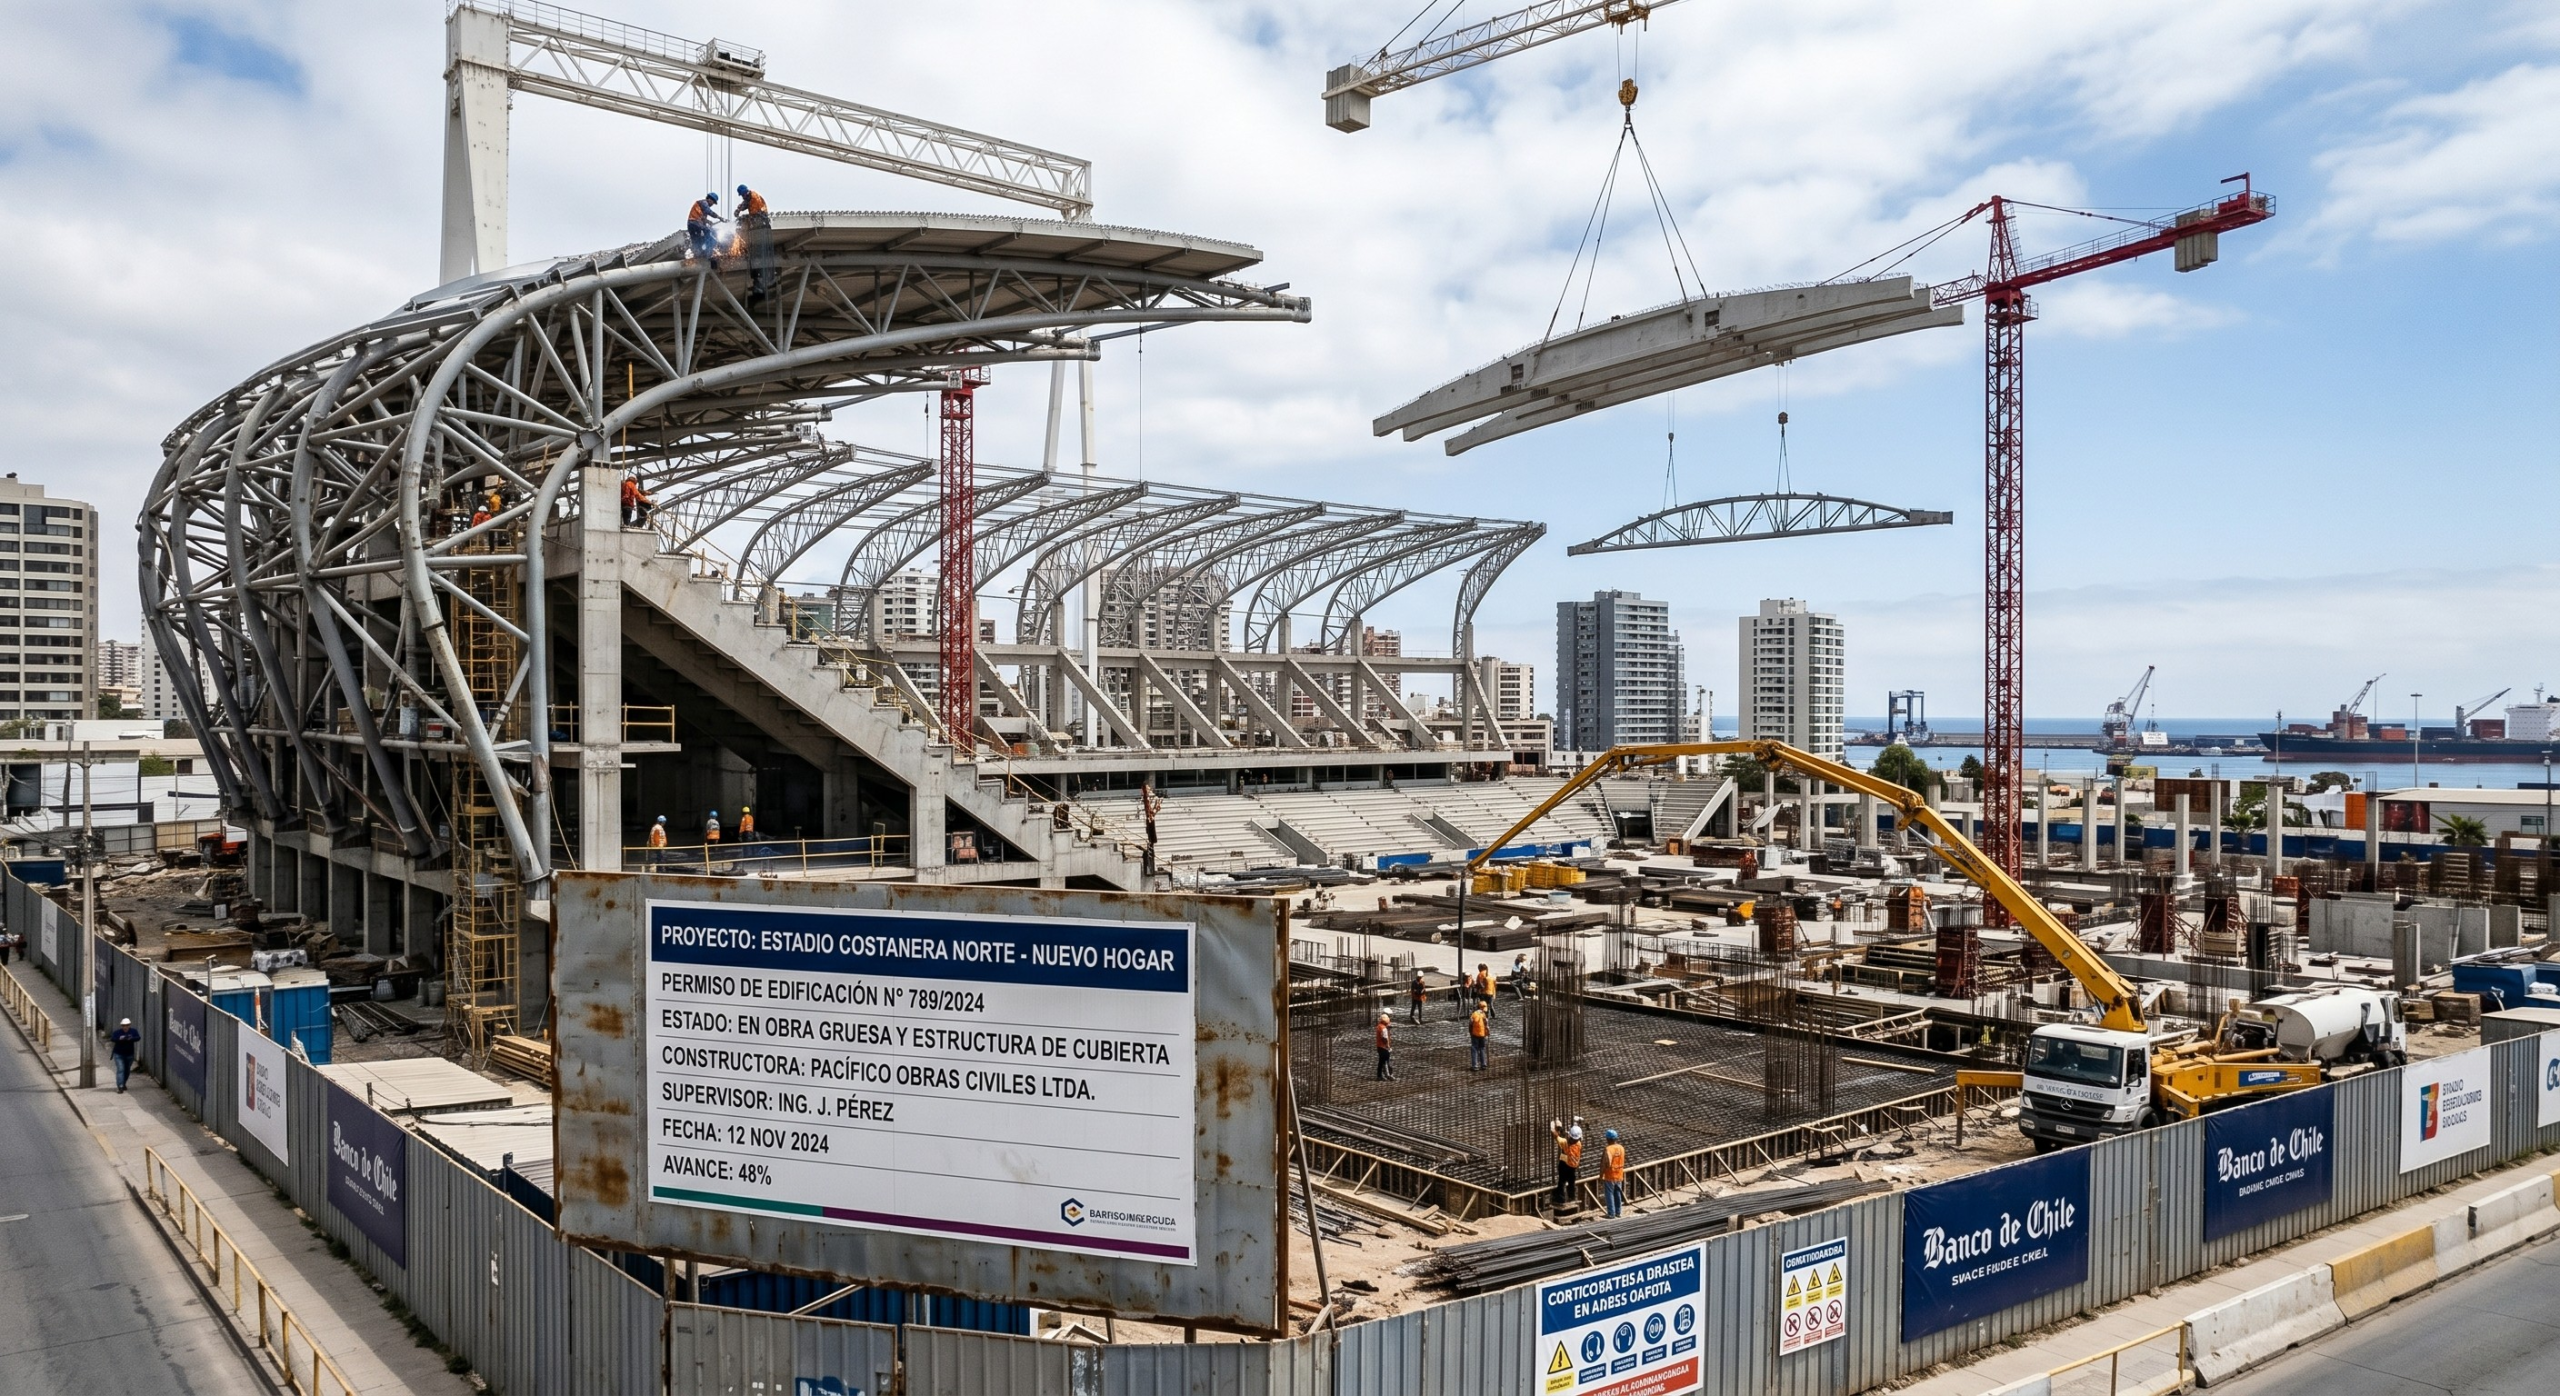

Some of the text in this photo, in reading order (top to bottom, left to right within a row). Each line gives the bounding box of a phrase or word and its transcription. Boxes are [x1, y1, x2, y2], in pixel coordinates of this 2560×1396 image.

[661, 925, 756, 949] PROYECTO:
[761, 931, 834, 954] ESTADIO
[839, 934, 948, 960] COSTANERA
[953, 941, 1016, 964] NORTE
[1032, 944, 1098, 968] NUEVO
[1103, 948, 1175, 971] HOGAR
[662, 972, 735, 996] PERMISO
[740, 978, 762, 998] DE
[768, 980, 878, 1006] EDIFICACIÓN
[908, 989, 984, 1012] 789/2024
[662, 1009, 1170, 1065] ESTADO: EN OBRA GRUESA Y ESTRUCTURA DE CUBIERTA
[662, 1045, 1095, 1100] CONSTRUCTORA: PACÍFICO OBRAS CIVILES LTDA.
[662, 1082, 894, 1122] SUPERVISOR: ING. J. PÉREZ
[662, 1118, 829, 1153] FECHA: 12 NOV 2024
[2217, 1126, 2323, 1183] Banco de Chile
[334, 1121, 358, 1171] Banco
[362, 1147, 371, 1181] de
[374, 1155, 397, 1202] Chile
[663, 1155, 772, 1185] AVANCE: 48%
[1923, 1197, 2075, 1270] Banco de Chile
[1574, 1302, 1589, 1319] EN
